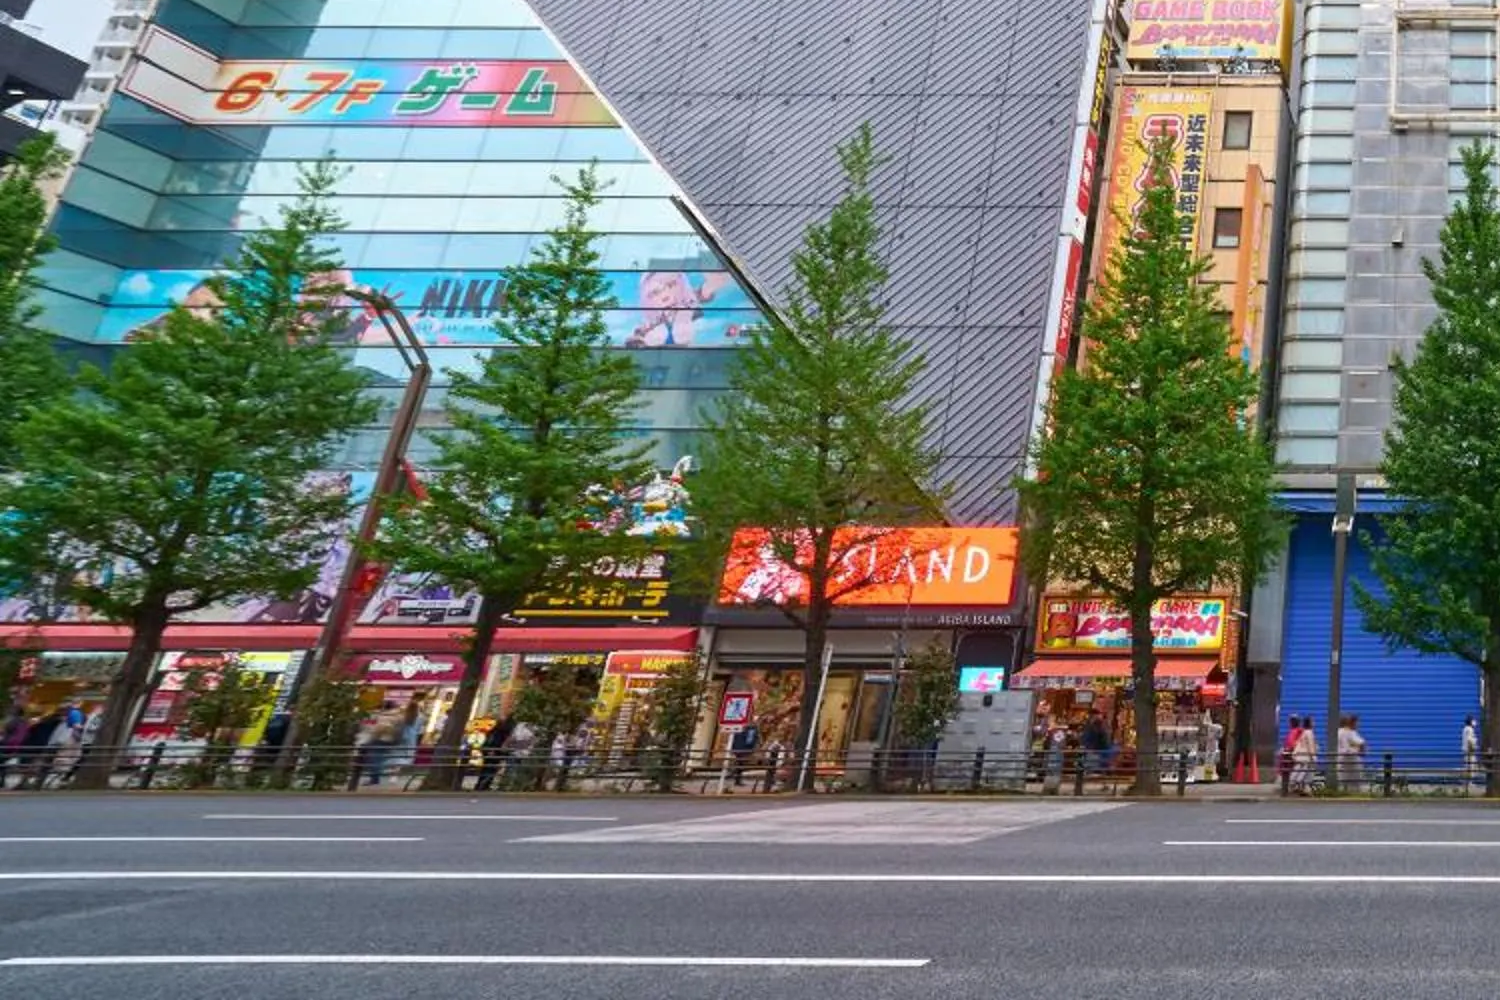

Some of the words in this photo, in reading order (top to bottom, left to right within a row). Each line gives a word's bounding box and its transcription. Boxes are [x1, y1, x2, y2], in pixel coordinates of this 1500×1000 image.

[394, 62, 557, 116] ゲーム
[973, 615, 1011, 625] ISLAND
